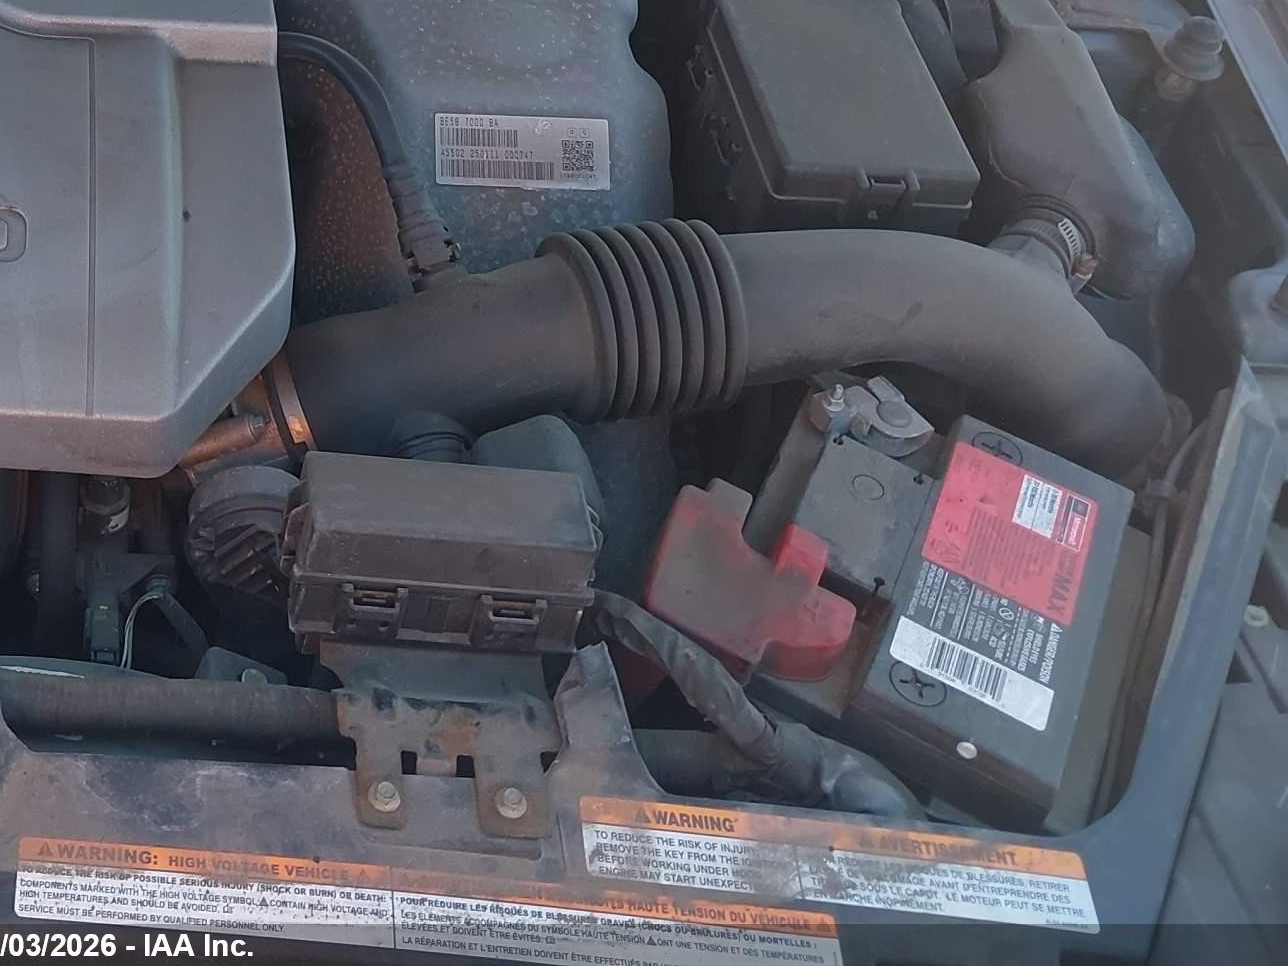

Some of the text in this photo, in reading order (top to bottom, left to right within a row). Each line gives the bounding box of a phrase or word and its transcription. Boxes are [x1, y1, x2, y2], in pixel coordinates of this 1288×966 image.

[1046, 572, 1073, 617] MAX
[653, 809, 735, 832] WARNING
[594, 830, 608, 840] TO
[611, 832, 653, 844] REDUCE
[656, 836, 675, 846] THE
[678, 839, 701, 850] RISK
[704, 841, 718, 851] OF
[58, 844, 349, 880] WARNING: HIGH VOLTAGE VEHICLE
[596, 842, 739, 866] REMOVE THE KEY FROM THE
[640, 869, 661, 880] MAY
[664, 872, 696, 885] START
[693, 864, 728, 876] UNDER
[20, 879, 78, 891] COMPONENTS
[80, 883, 116, 894] MARKED
[118, 886, 139, 896] WITH
[142, 888, 157, 897] THE
[160, 890, 180, 899] HIGH
[183, 892, 221, 903] VOLTAGE
[270, 899, 306, 910] CONTAIN
[308, 903, 328, 912] HIGH
[331, 904, 369, 915] VOLTAGE
[134, 874, 177, 885] POSSIBLE
[179, 878, 219, 889] SERIOUS
[222, 880, 255, 891] INJURY
[257, 883, 291, 894] (SHOCK
[294, 887, 306, 895] OR
[309, 888, 336, 899] BURN)
[354, 893, 386, 902] DEATH:
[929, 878, 961, 891] AVANT
[1050, 894, 1072, 904] DES
[1028, 879, 1070, 892] RETIRER
[19, 890, 40, 898] HIGH
[43, 892, 109, 904] TEMPERATURES
[111, 897, 129, 905] AND
[131, 899, 165, 909] SHOULD
[167, 901, 179, 909] BE
[945, 891, 960, 903] LE
[960, 893, 1003, 908] MOTEUR
[1003, 899, 1029, 911] PEUT
[1031, 902, 1045, 913] SE
[1046, 904, 1087, 919] METTRE
[18, 904, 55, 914] SERVICE
[56, 907, 79, 916] MUST
[82, 909, 93, 917] BE
[96, 910, 148, 922] PERFORMED
[150, 914, 161, 923] BY
[163, 915, 208, 927] QUALIFIED
[209, 919, 260, 931] PERSONNEL
[400, 896, 426, 907] POUR
[428, 898, 467, 911] RÉDUIRE
[470, 903, 487, 912] LES
[489, 904, 529, 917] RISQUES
[531, 910, 543, 919] DE
[743, 933, 756, 942] OU
[759, 936, 811, 948] MORTELLES
[730, 911, 746, 923] DU
[441, 924, 450, 933] ET
[453, 925, 487, 938] DOIVENT
[528, 923, 539, 932] DU
[541, 925, 579, 937] SYMBOLE
[581, 929, 609, 940] HAUTE
[612, 931, 645, 944] TENSION
[657, 938, 673, 947] ONT
[676, 940, 692, 949] UNE
[695, 942, 729, 954] TENSION
[731, 947, 741, 955] ET
[743, 947, 758, 957] DES
[415, 936, 466, 950] RÉPARATION
[468, 942, 478, 950] ET
[480, 943, 532, 957] L'ENTRETIEN
[534, 948, 569, 961] DOIVENT
